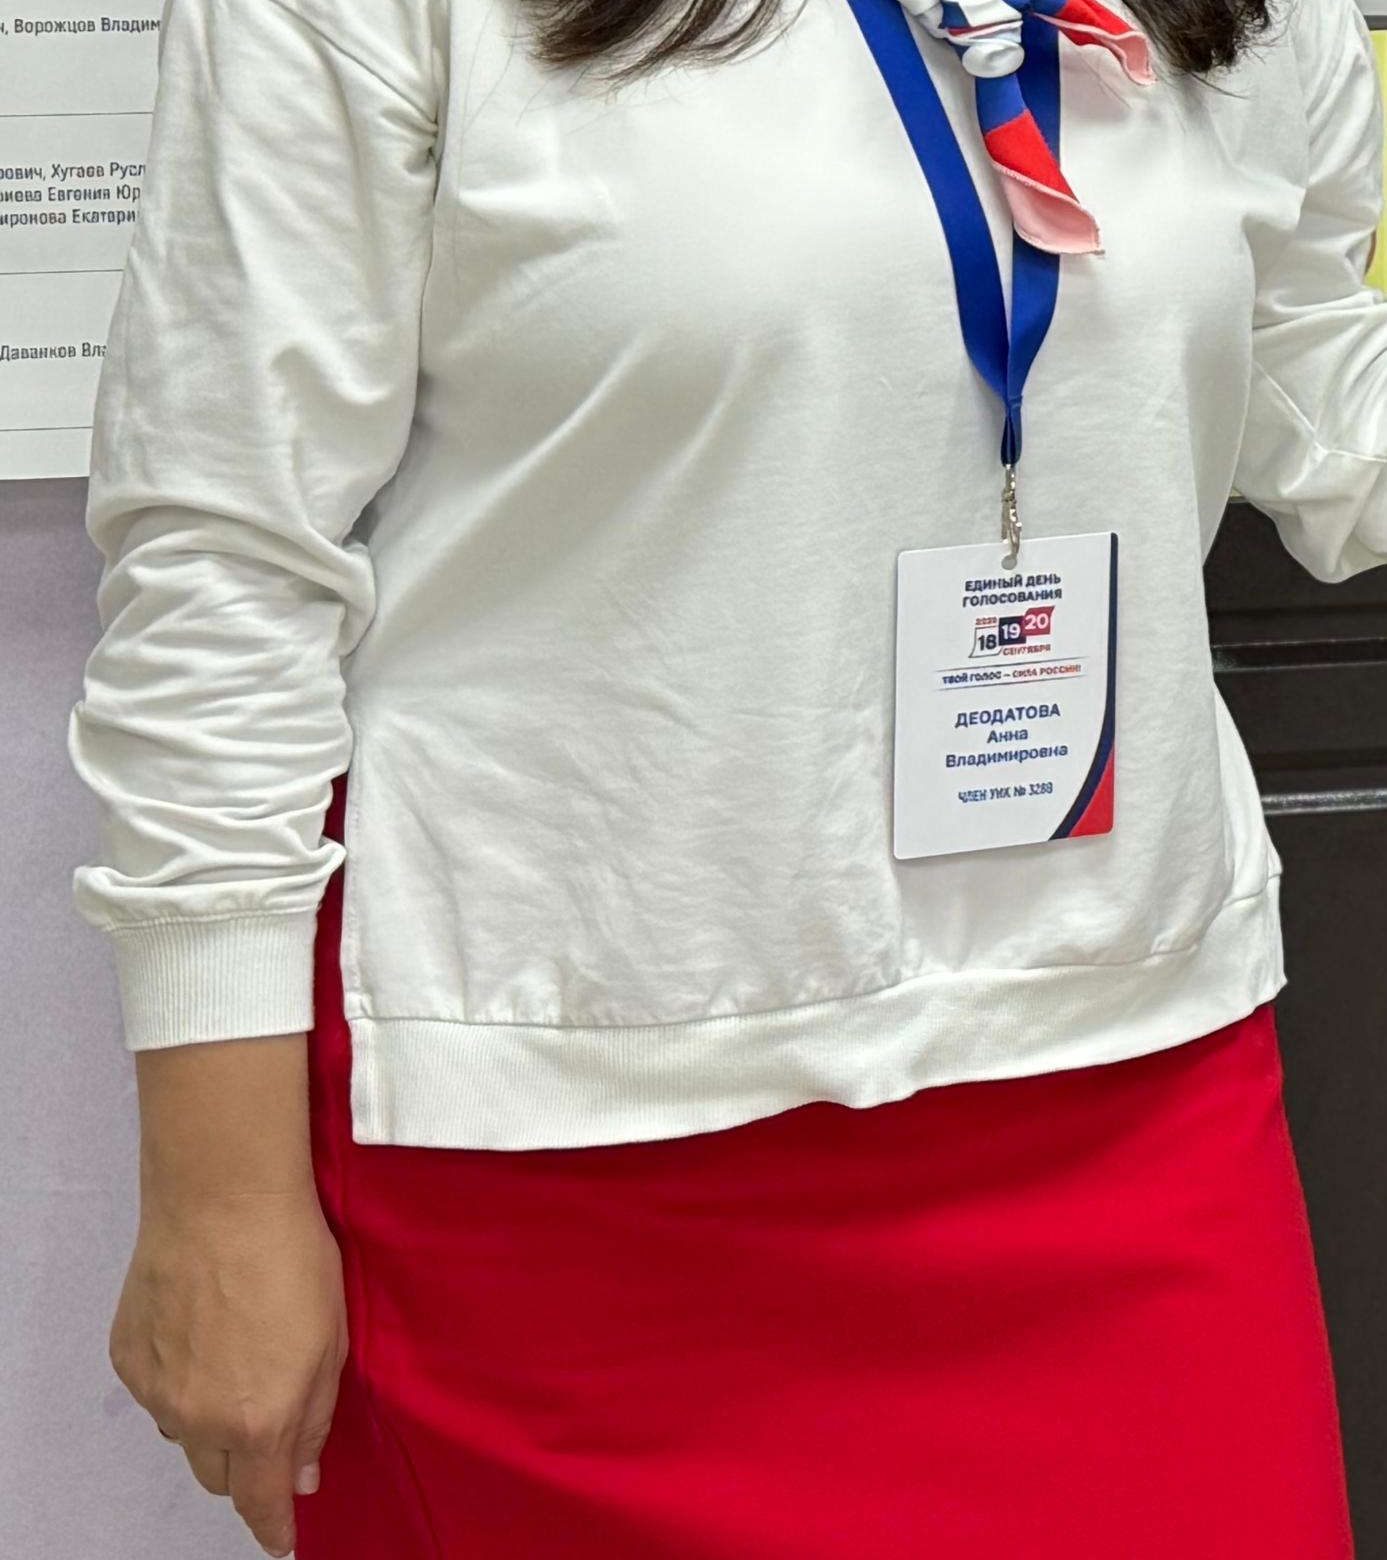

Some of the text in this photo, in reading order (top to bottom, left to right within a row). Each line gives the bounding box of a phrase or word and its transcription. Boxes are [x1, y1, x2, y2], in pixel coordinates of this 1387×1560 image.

[14, 18, 96, 37] Ворожцов
[51, 163, 105, 182] Хугаев
[48, 186, 110, 202] Евгения
[0, 344, 76, 361] Даванков
[965, 573, 1062, 592] ЕДИНЫЙ ДЕНЬ
[962, 589, 1063, 608] ГОЛОСОВАНИЯ
[978, 613, 1049, 651] 18 19 20
[955, 703, 1061, 728] ДЕОДАТОВА
[987, 729, 1028, 743] Анна
[945, 745, 1068, 768] Владимировна
